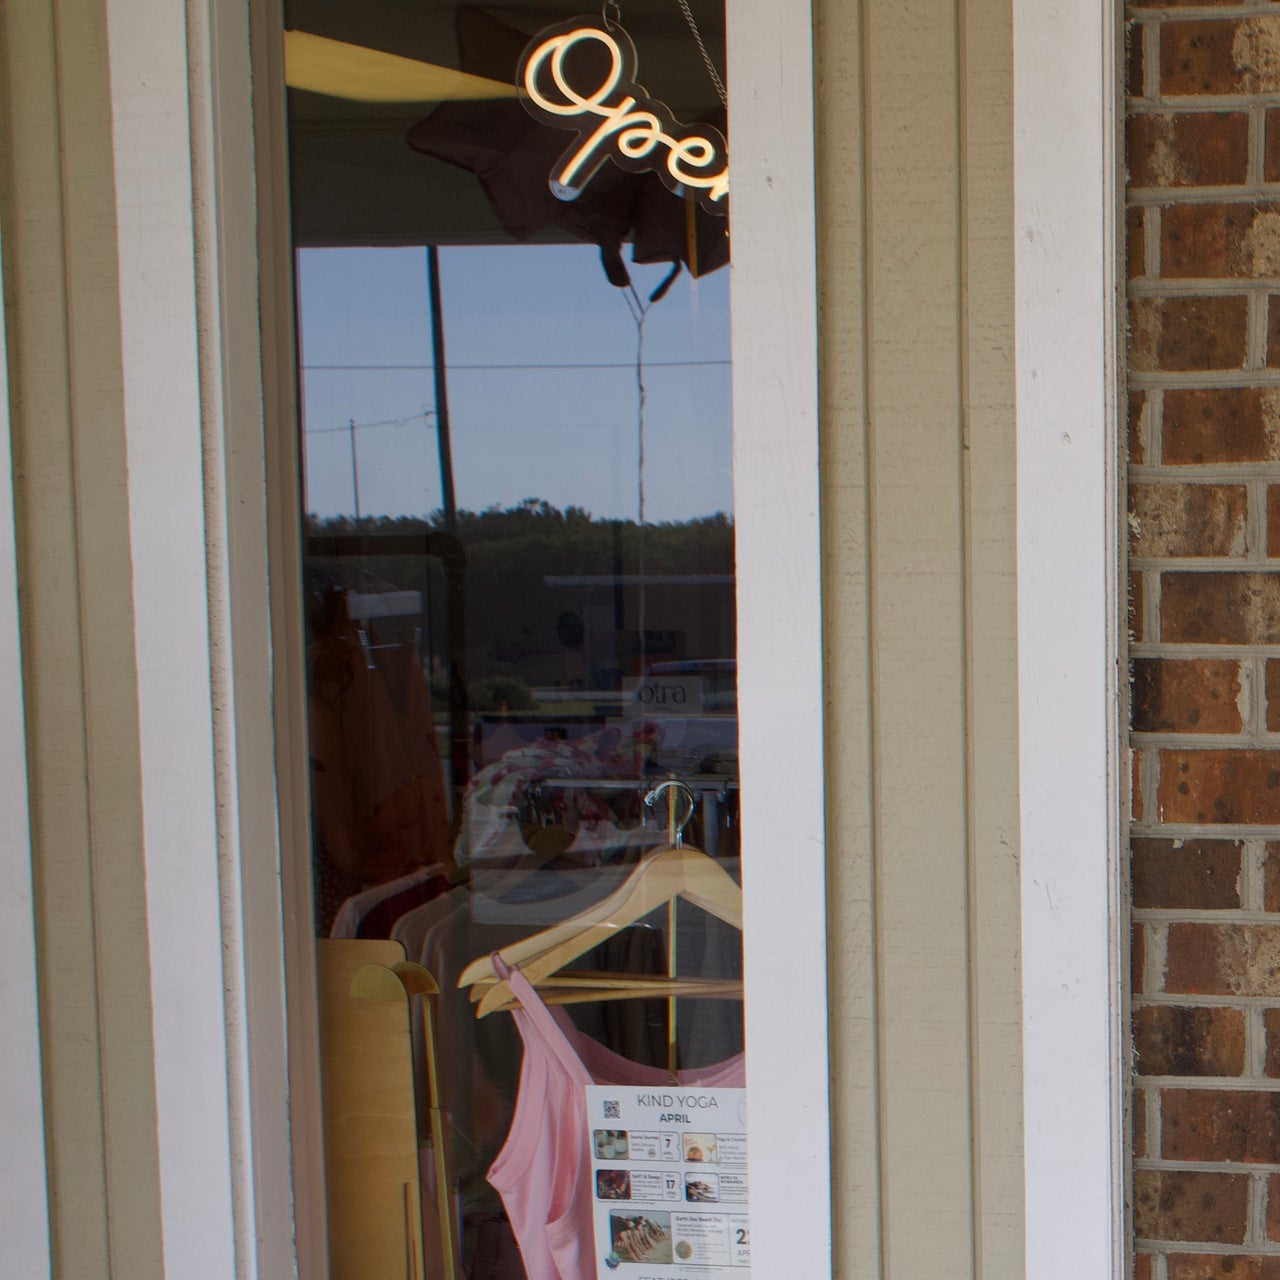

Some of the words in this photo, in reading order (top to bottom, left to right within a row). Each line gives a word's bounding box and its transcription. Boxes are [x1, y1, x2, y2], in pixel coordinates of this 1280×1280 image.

[639, 683, 686, 704] otra
[637, 1094, 674, 1107] KIND
[675, 1095, 719, 1108] YOGA
[659, 1113, 691, 1123] APRIL
[665, 1138, 671, 1148] 7
[666, 1179, 675, 1189] 17
[736, 1228, 750, 1245] 2
